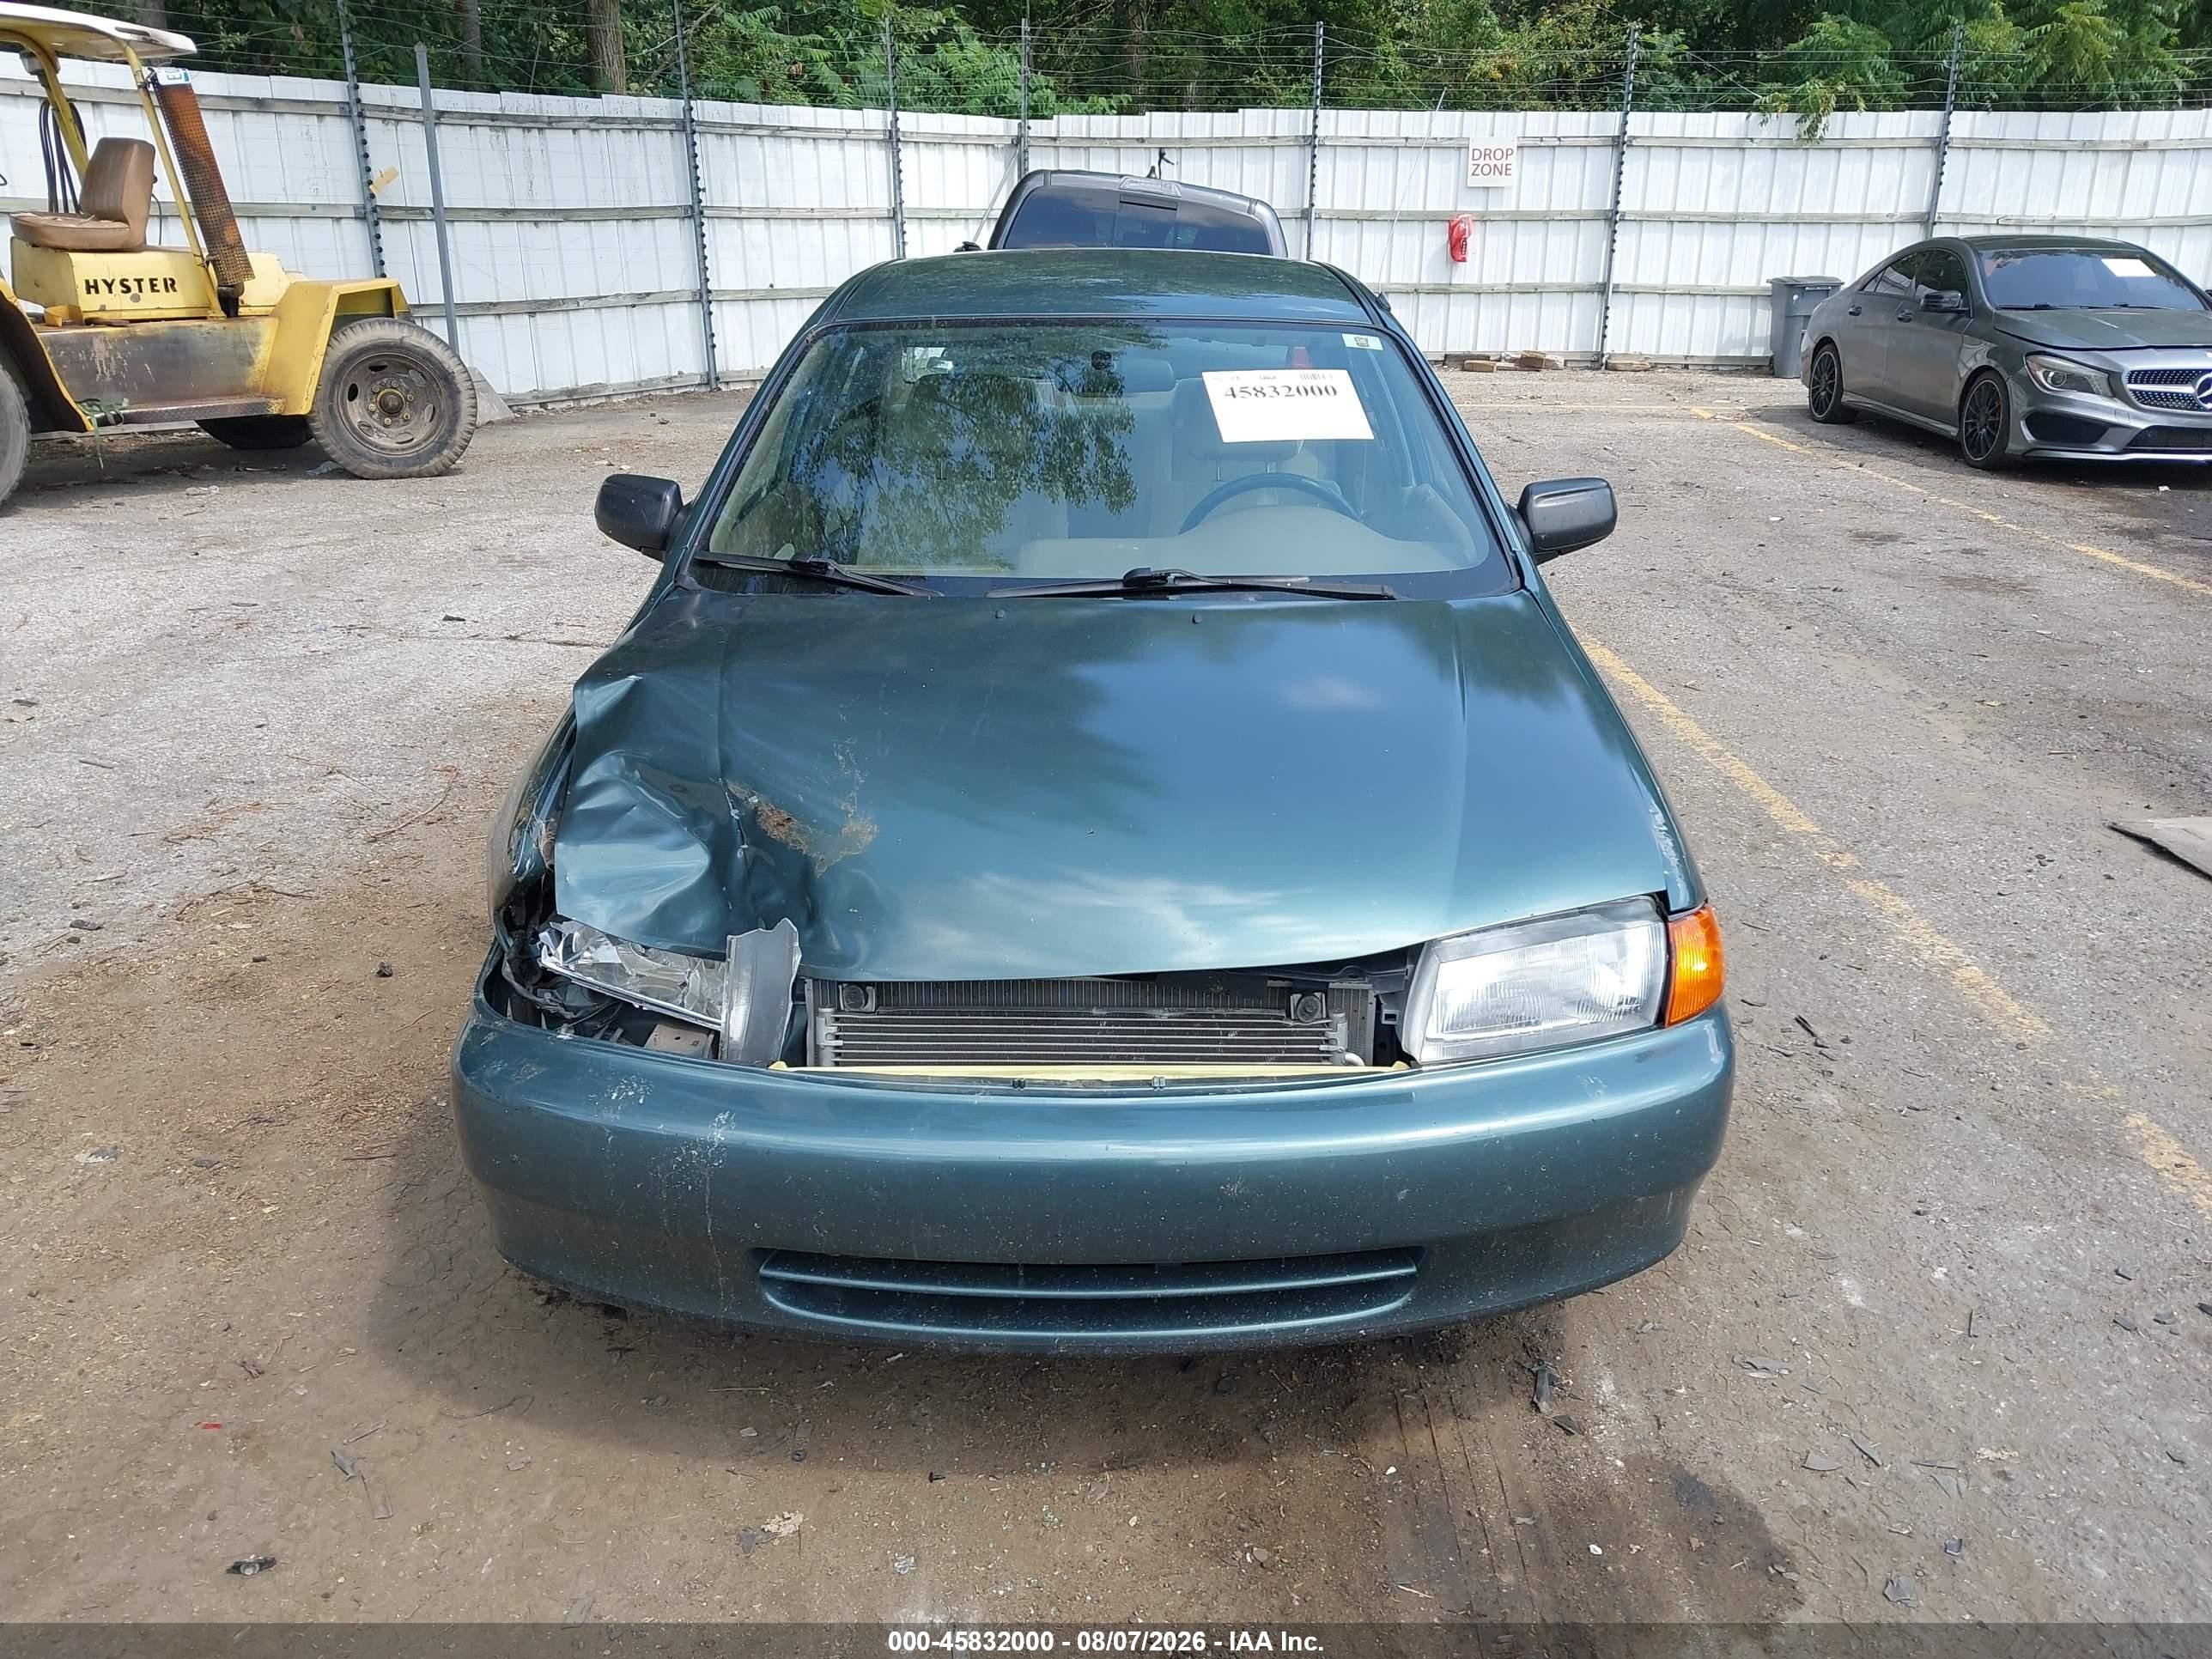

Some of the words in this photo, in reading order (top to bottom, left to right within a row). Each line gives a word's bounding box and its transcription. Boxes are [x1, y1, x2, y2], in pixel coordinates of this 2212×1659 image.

[1472, 148, 1514, 161] DROP
[1471, 163, 1512, 177] ZONE
[84, 277, 178, 295] HYSTER
[1224, 385, 1338, 398] 45832000
